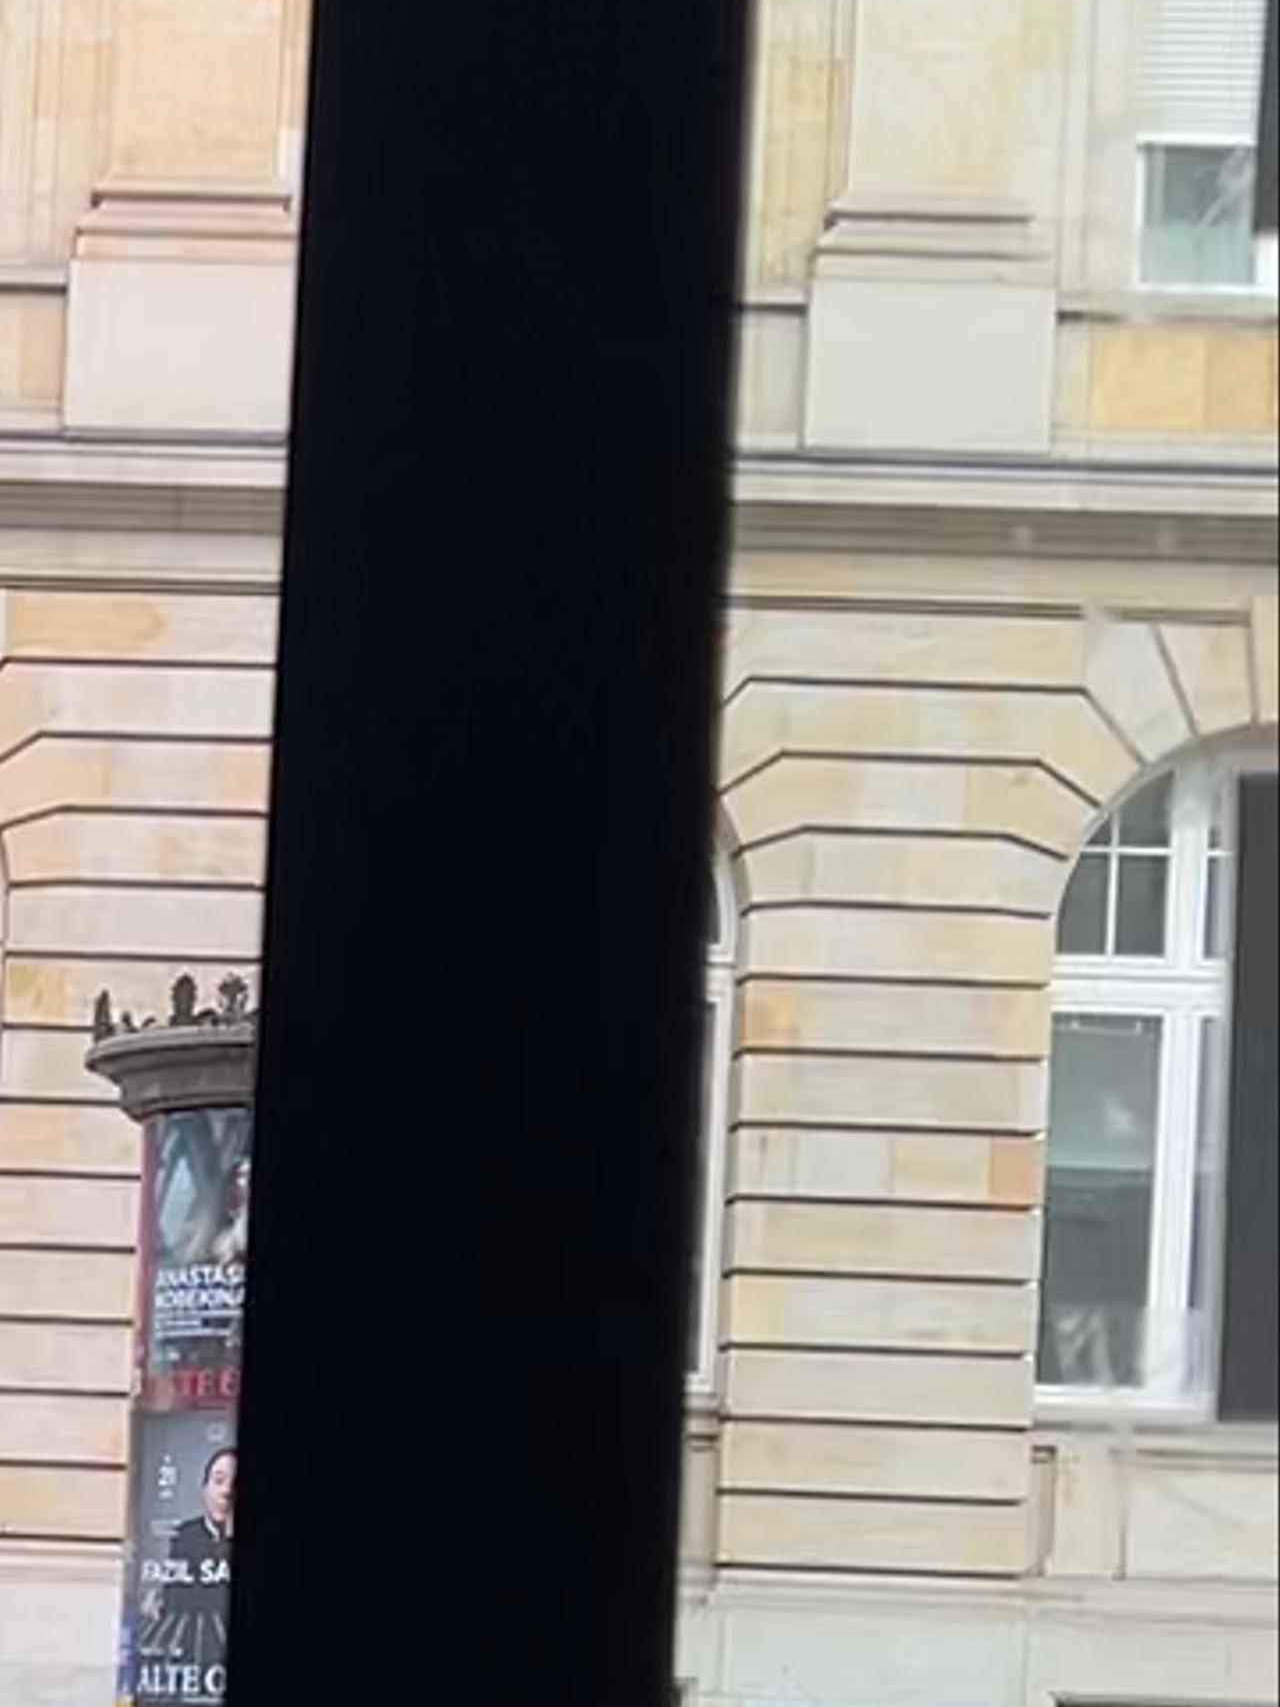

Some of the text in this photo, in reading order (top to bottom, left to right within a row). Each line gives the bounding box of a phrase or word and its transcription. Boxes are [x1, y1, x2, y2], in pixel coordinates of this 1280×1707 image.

[155, 1265, 246, 1287] ANASTAS
[200, 1558, 231, 1584] SA
[137, 1664, 227, 1695] ALTE O
